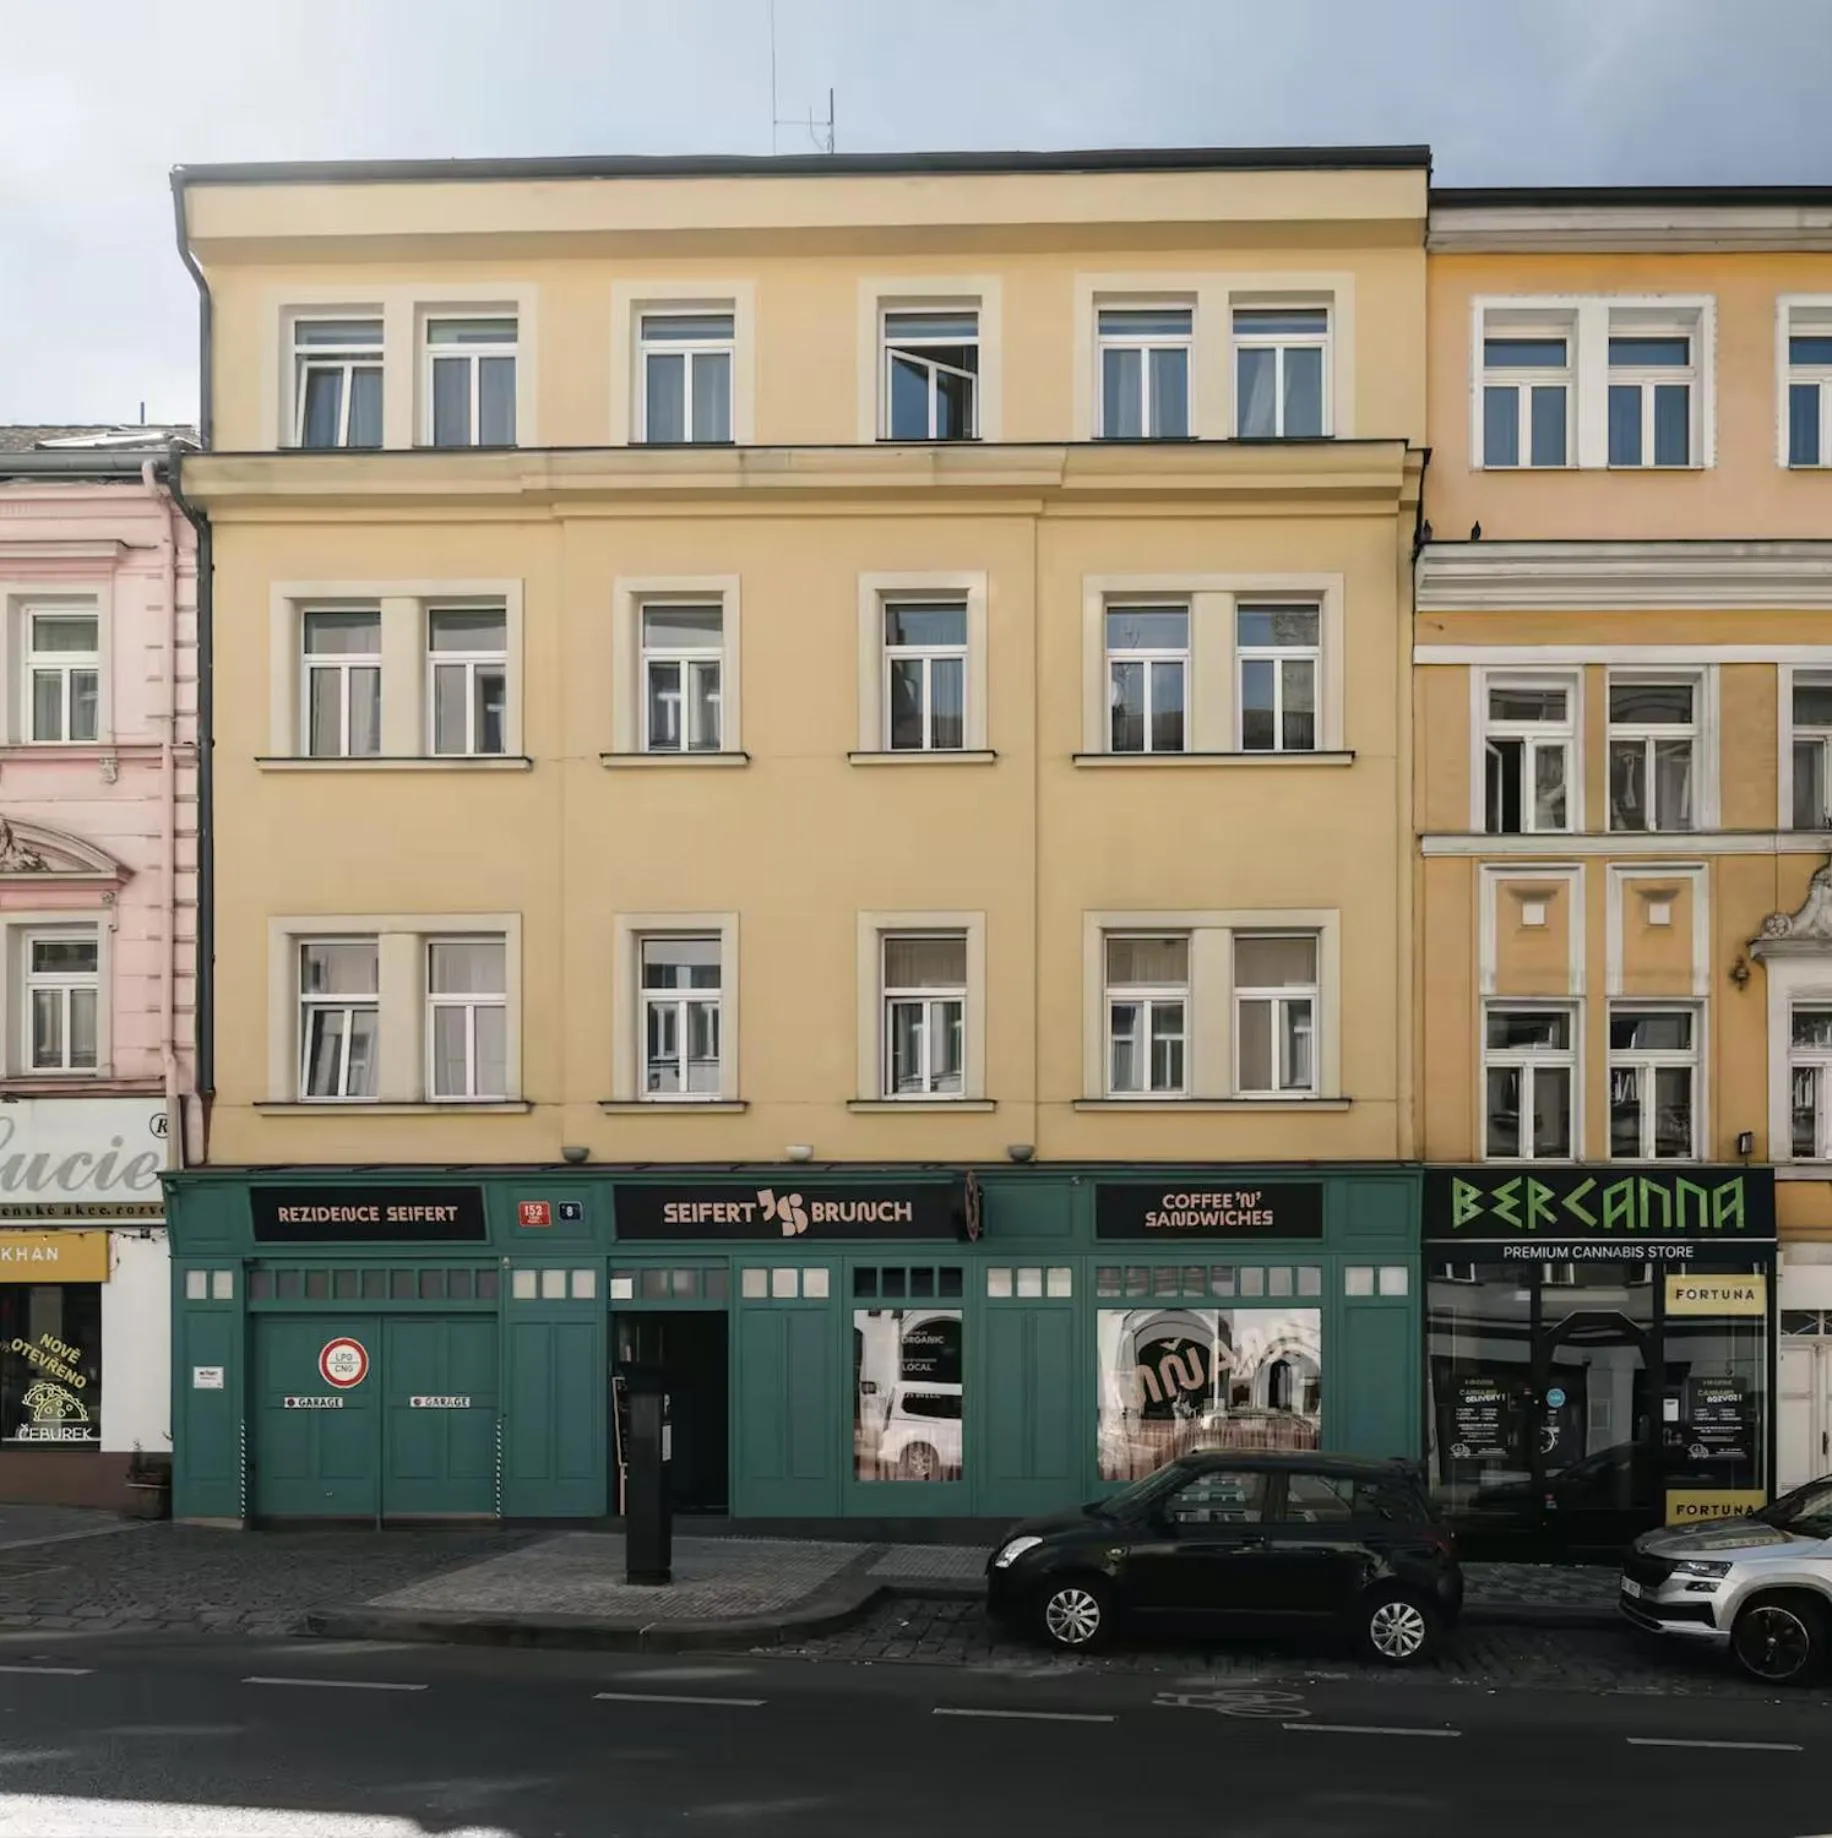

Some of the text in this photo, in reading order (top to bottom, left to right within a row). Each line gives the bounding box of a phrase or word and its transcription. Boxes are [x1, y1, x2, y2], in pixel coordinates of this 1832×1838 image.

[1162, 1193, 1233, 1209] COFFEE
[1452, 1176, 1745, 1229] BERCANNA
[278, 1206, 458, 1222] REZIDENCE SEIFERT
[524, 1205, 543, 1217] 152
[566, 1206, 573, 1217] 8
[663, 1202, 756, 1223] SEIFERT
[811, 1202, 912, 1222] BRUNCH
[1145, 1210, 1273, 1226] SANDWICHES
[1, 1248, 59, 1261] KHAN
[1503, 1246, 1694, 1258] PREMIUM CANNABIS STORE
[1675, 1289, 1755, 1300] FORTUNA
[11, 1338, 87, 1389] OTEVŘENO
[902, 1363, 933, 1371] LOCAL
[299, 1398, 341, 1407] GARAGE
[425, 1397, 468, 1407] GARAGE
[18, 1423, 93, 1441] ČEBUREK
[1675, 1505, 1754, 1516] FORTUNA
